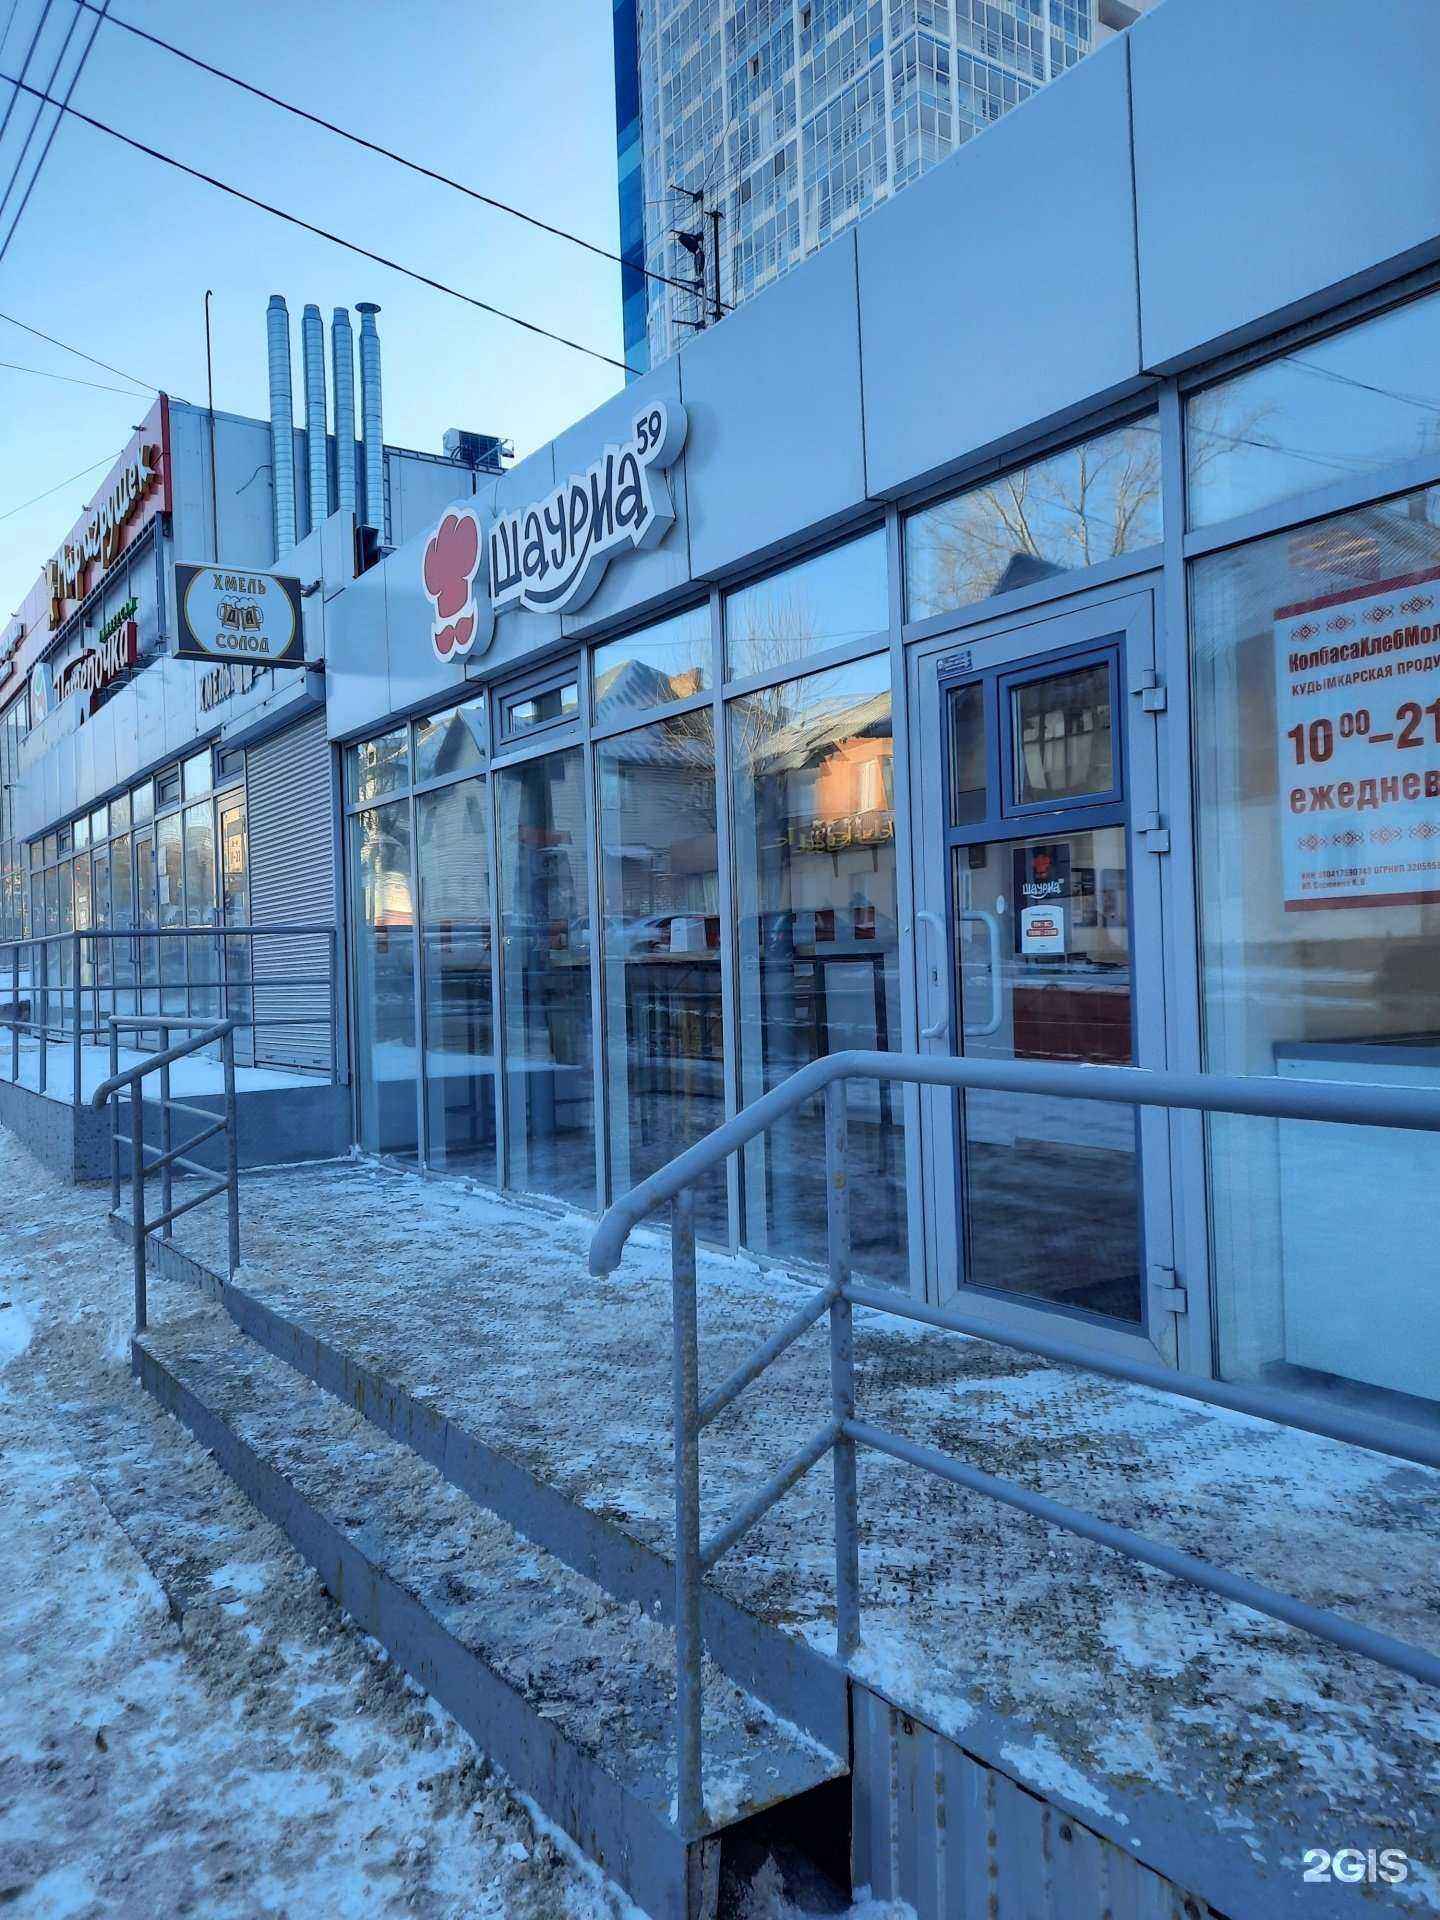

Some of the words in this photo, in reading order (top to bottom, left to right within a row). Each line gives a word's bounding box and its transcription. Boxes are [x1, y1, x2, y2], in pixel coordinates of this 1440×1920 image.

[636, 410, 662, 455] 59
[212, 573, 268, 595] ХМЕЛЬ
[215, 633, 270, 653] СОЛОД
[1291, 665, 1393, 696] КУДЫМКАРСКАЯ
